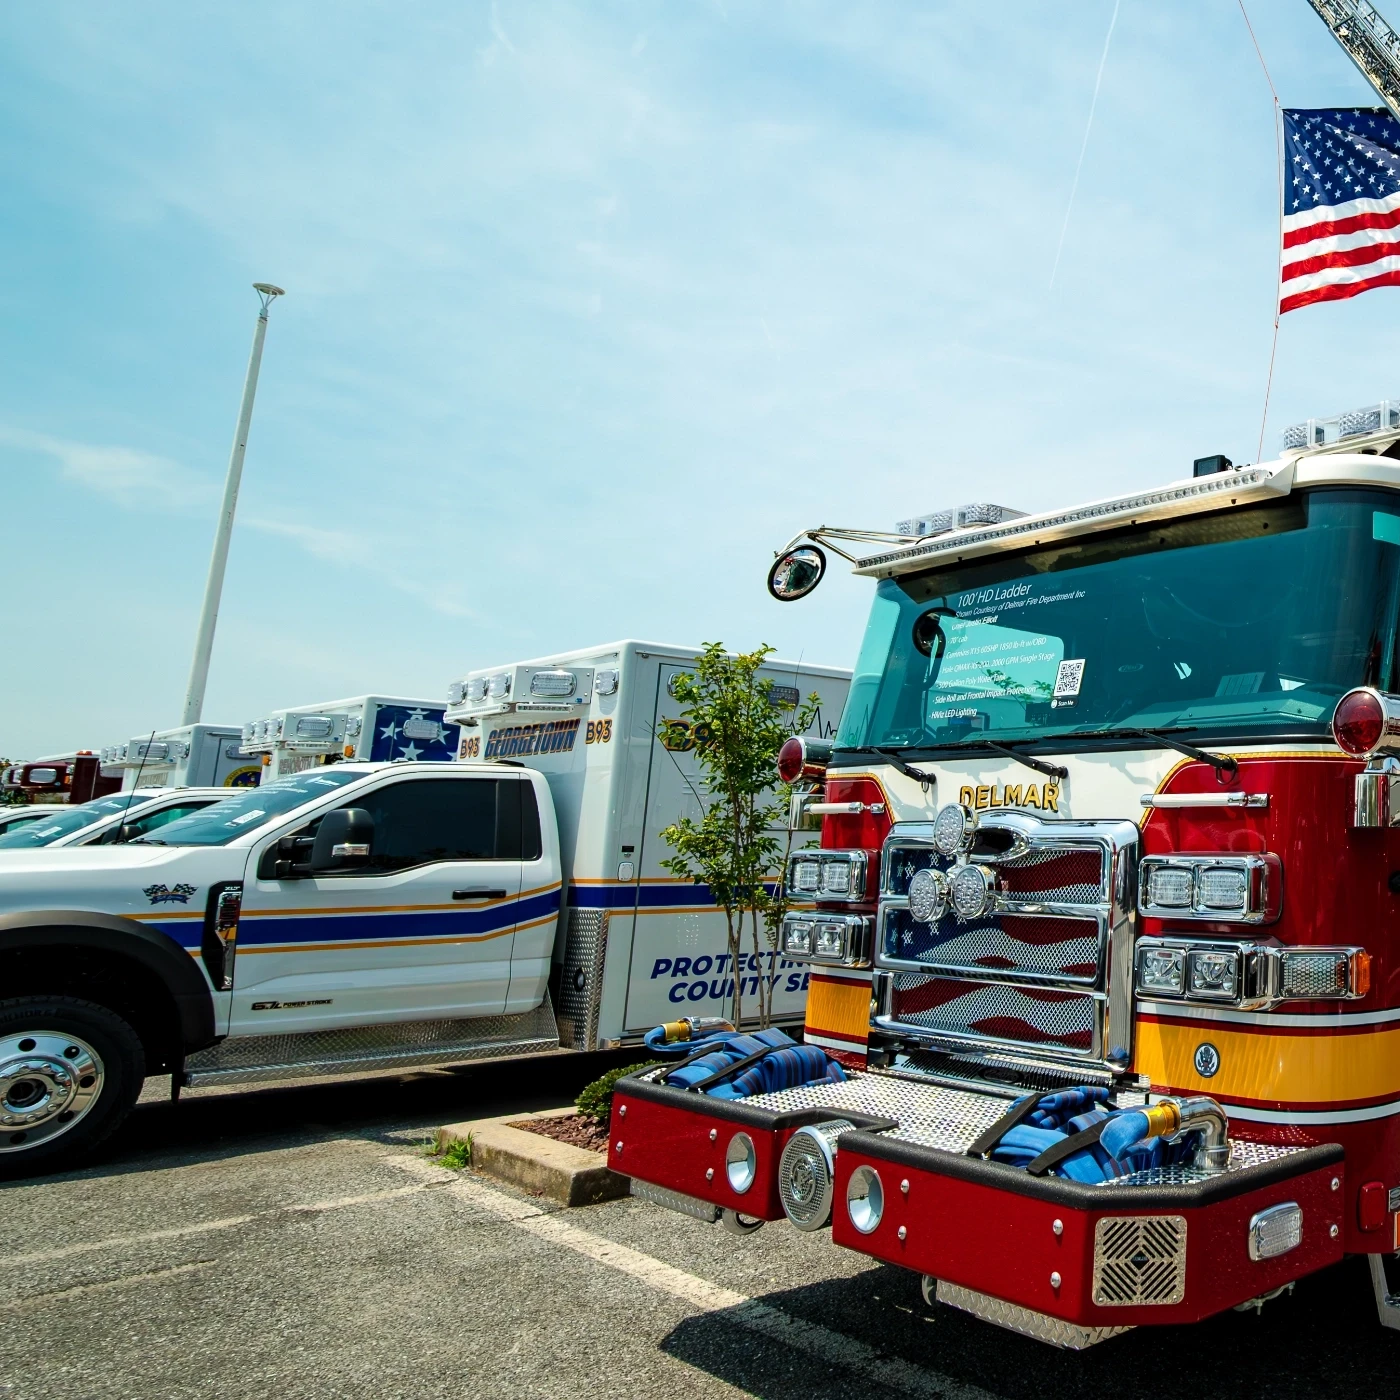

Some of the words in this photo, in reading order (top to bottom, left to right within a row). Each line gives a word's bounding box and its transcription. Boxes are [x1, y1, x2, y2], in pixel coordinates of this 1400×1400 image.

[955, 609, 972, 618] Shown
[973, 604, 997, 615] Courtesy
[998, 602, 1006, 611] of
[1005, 600, 1026, 610] Delmar
[1025, 597, 1038, 606] Fire
[1039, 592, 1075, 605] Department
[1075, 590, 1086, 598] Inc
[958, 592, 978, 607] 100'
[978, 589, 994, 602] HD
[995, 583, 1032, 600] Ladder
[1020, 653, 1038, 663] Single
[1038, 652, 1055, 661] Stage
[935, 696, 946, 704] Side
[957, 692, 967, 700] and
[967, 690, 986, 699] Frontal
[986, 688, 1006, 699] Impact
[1006, 686, 1036, 695] Protection
[944, 709, 955, 718] LED
[955, 707, 978, 718] Lighting
[484, 718, 581, 760] GEORGETOWN
[585, 719, 612, 744] B93
[460, 736, 480, 759] B93
[960, 783, 1059, 813] DELMAR
[651, 950, 808, 979] PROTECTIN
[668, 974, 782, 1003] COUNTY
[785, 971, 810, 992] SE
[251, 1001, 282, 1011] 6.7L
